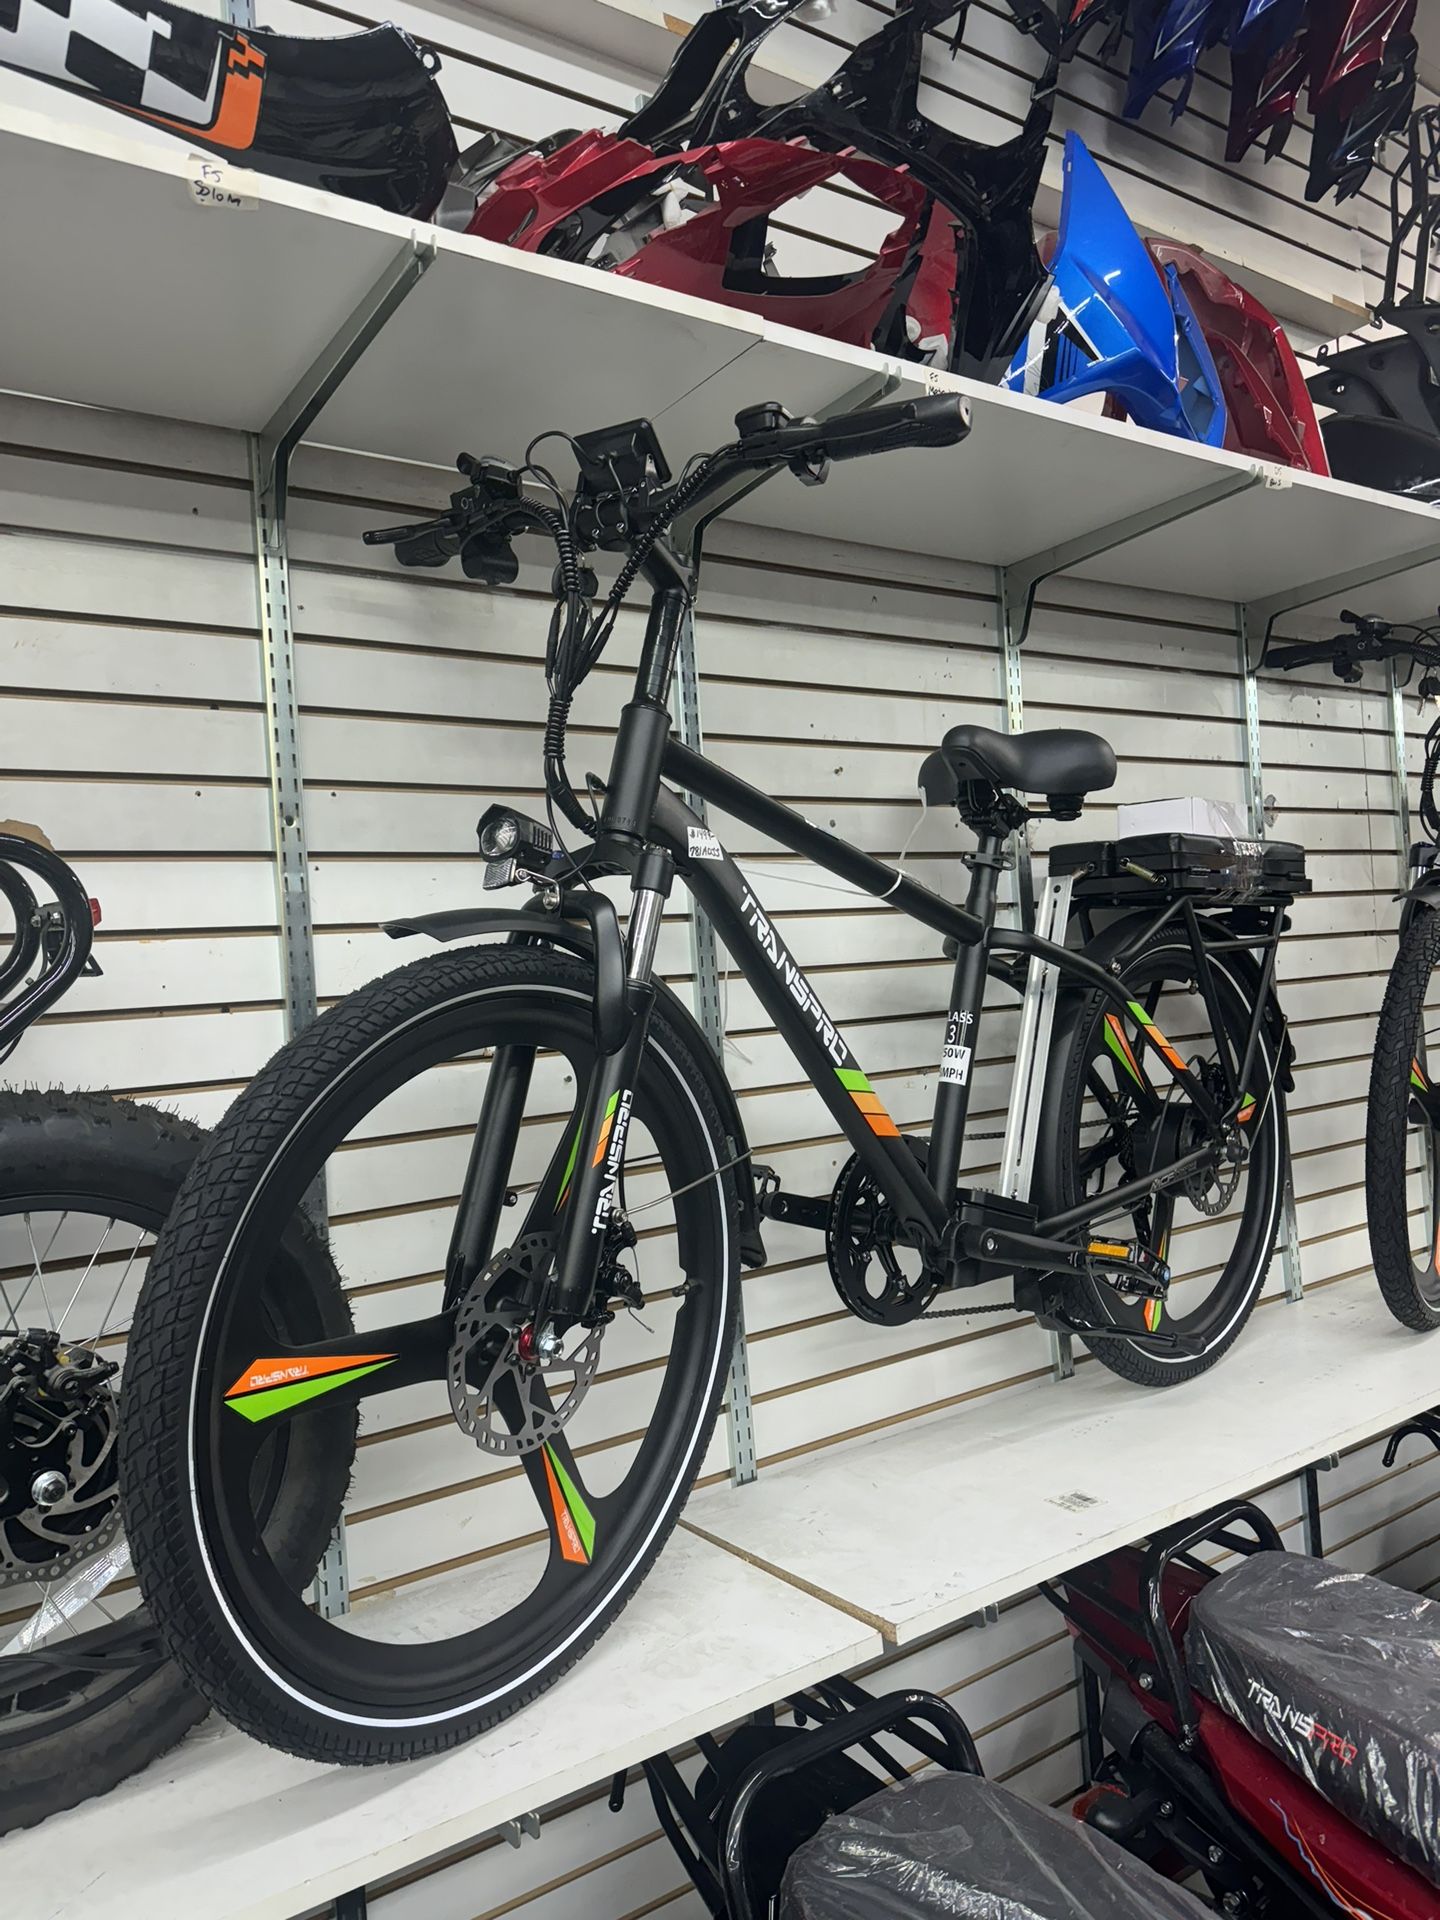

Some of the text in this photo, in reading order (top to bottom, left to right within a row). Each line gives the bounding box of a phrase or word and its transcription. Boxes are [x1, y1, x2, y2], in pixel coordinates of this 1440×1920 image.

[741, 885, 848, 1067] TRANSPRO
[948, 1010, 974, 1025] LASS
[947, 1024, 957, 1044] 3
[591, 1089, 634, 1234] TRANSPRO
[1247, 1678, 1358, 1766] TRANSPRO
